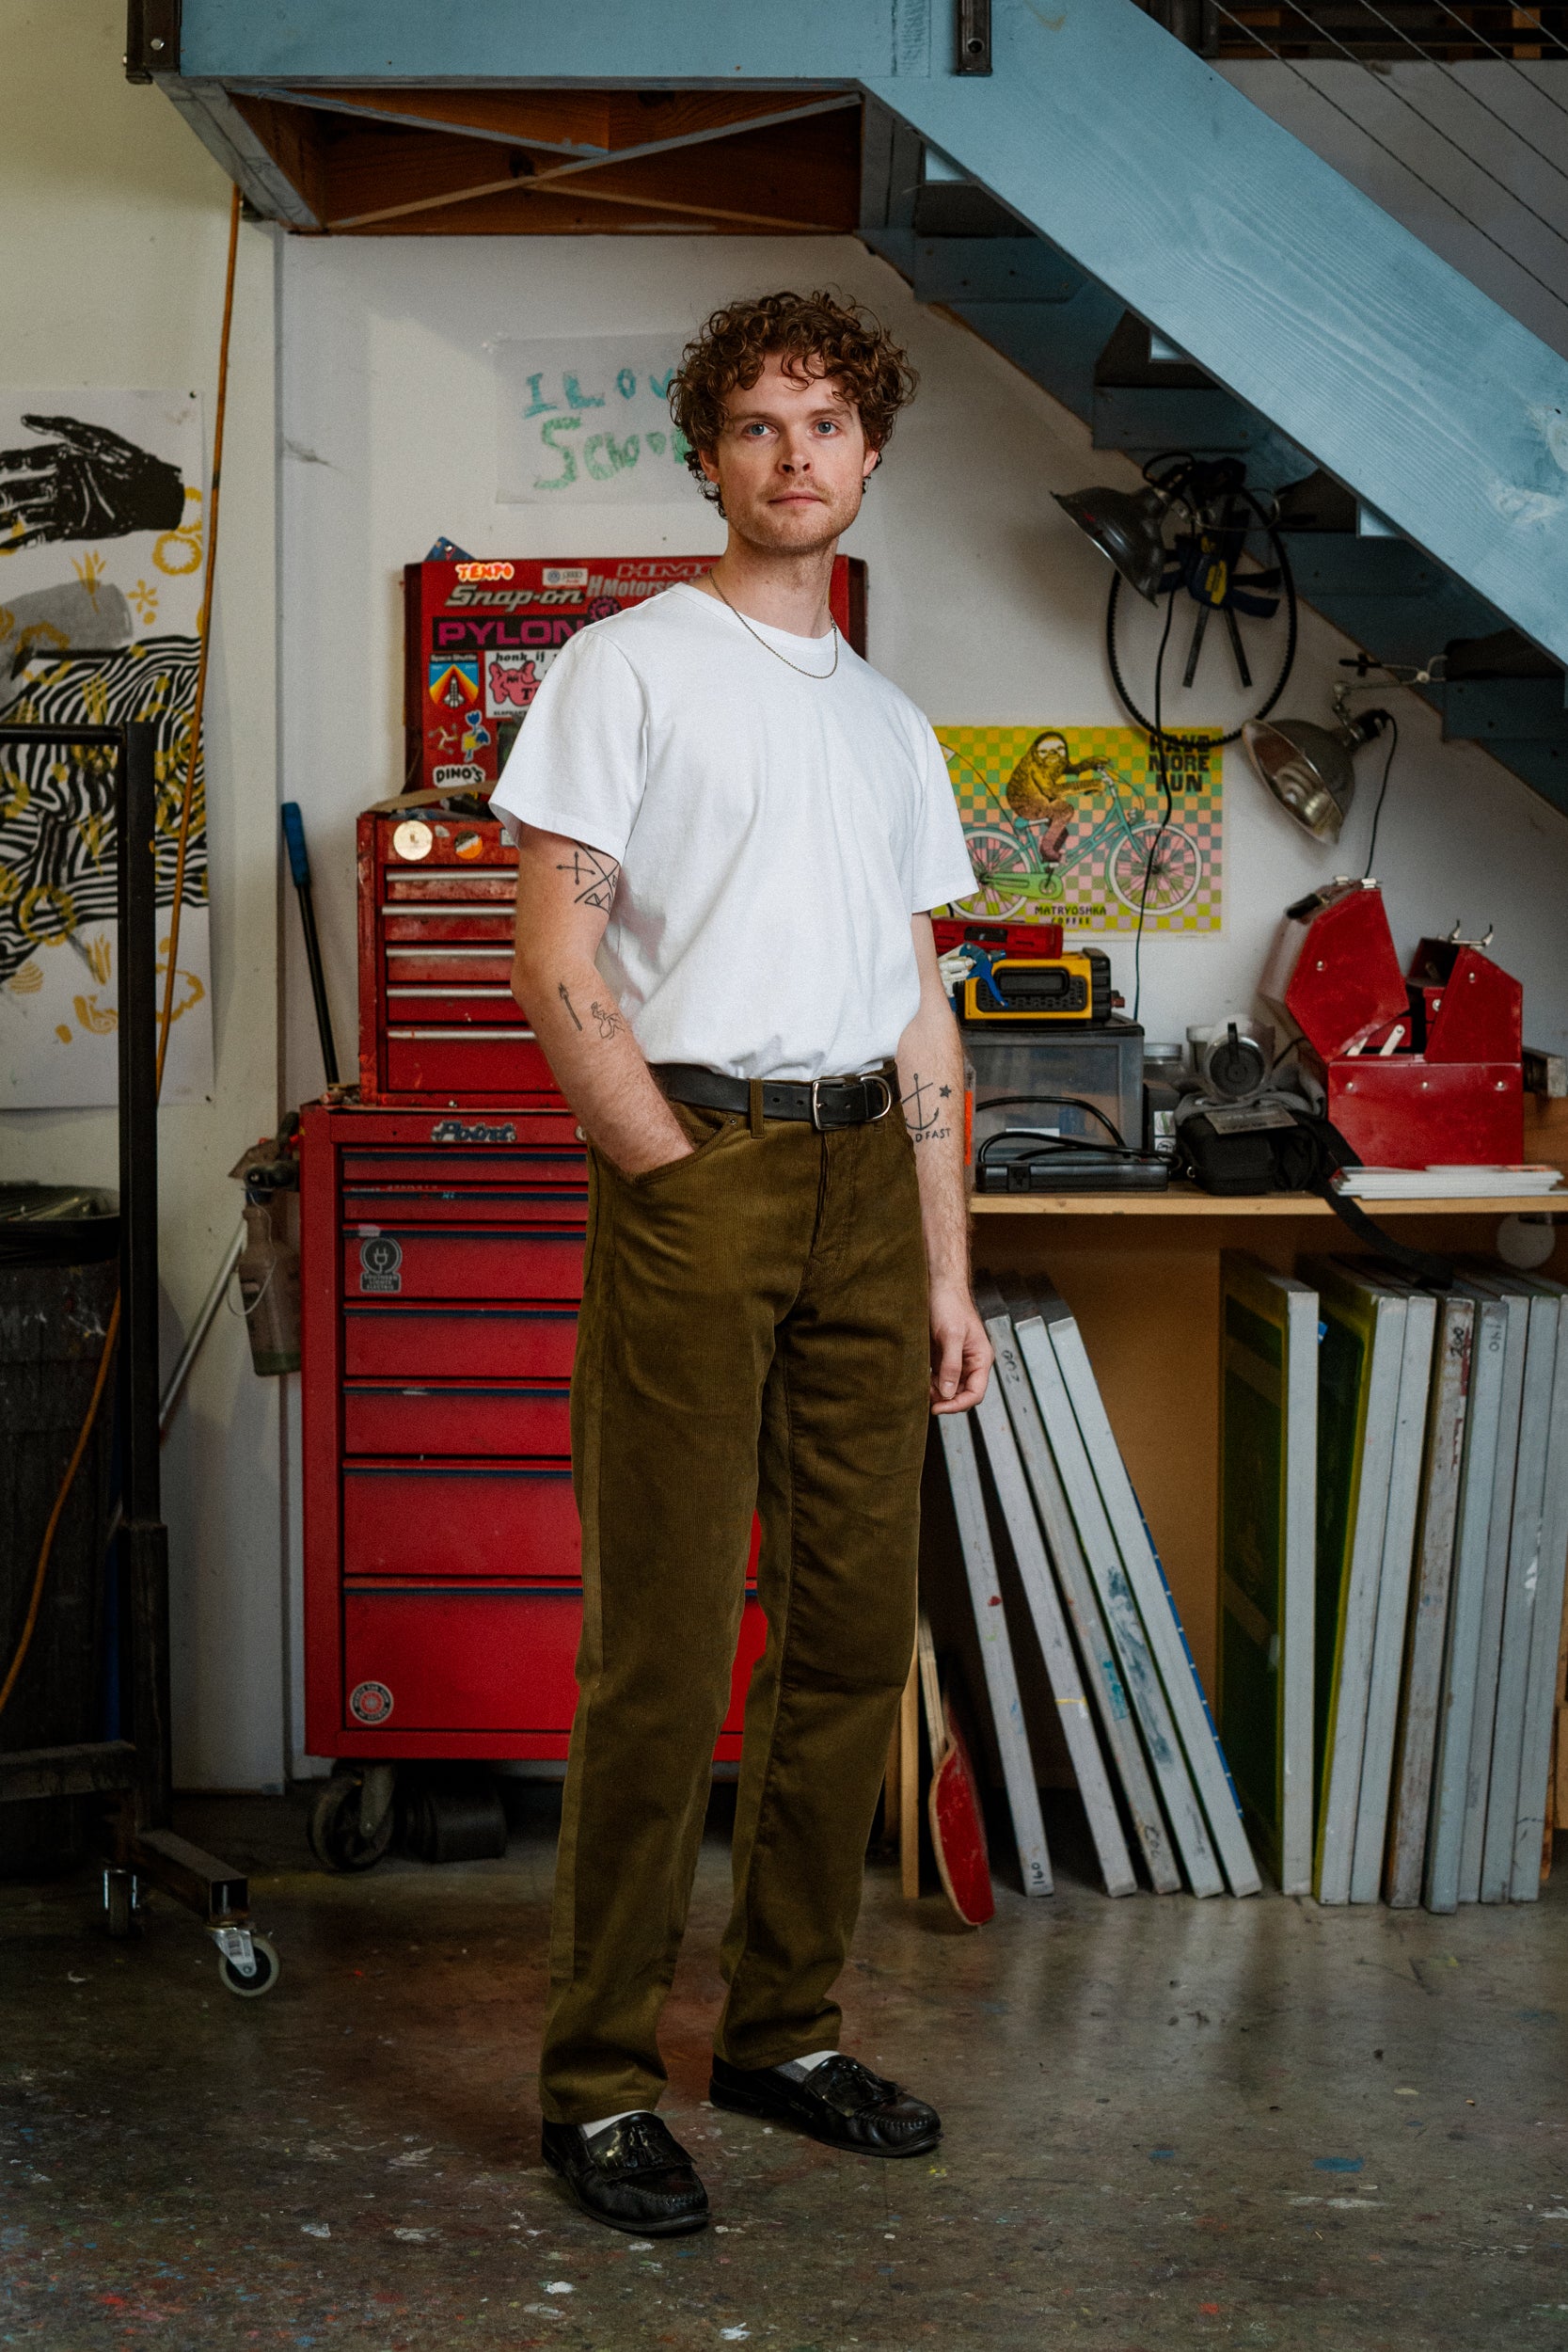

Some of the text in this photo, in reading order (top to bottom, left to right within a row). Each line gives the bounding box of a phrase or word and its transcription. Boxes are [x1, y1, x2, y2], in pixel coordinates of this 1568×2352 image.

[523, 368, 676, 420] I LOV
[456, 563, 514, 580] TEMPO
[445, 584, 584, 612] Snap-on
[438, 620, 585, 645] PYLON
[495, 652, 529, 662] honk
[535, 651, 546, 662] if
[1148, 755, 1210, 771] MORE
[436, 767, 483, 784] DINO'S
[1156, 774, 1202, 791] FUN
[1035, 905, 1106, 915] MATRYOSHKA
[926, 1128, 951, 1140] FAST
